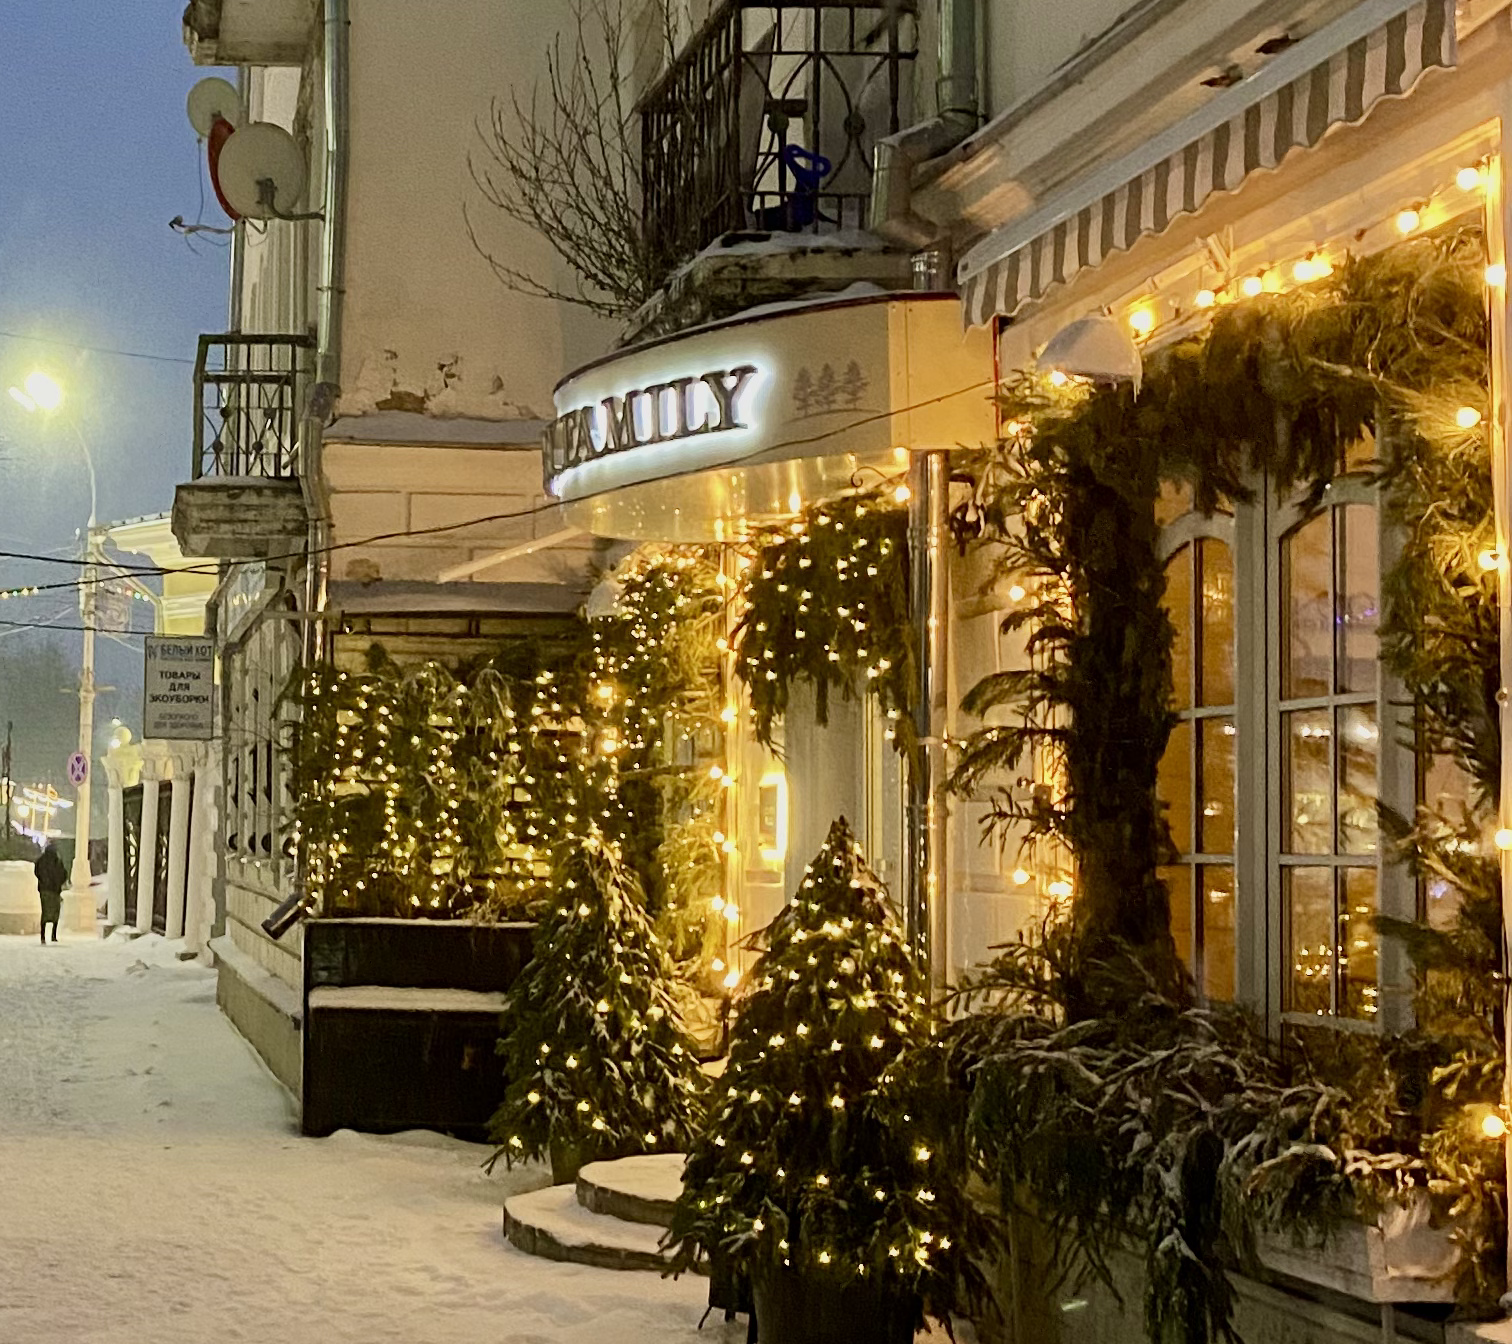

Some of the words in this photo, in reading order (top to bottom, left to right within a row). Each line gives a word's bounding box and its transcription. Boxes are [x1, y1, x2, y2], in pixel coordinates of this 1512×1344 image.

[559, 364, 758, 472] FAMILY
[159, 670, 201, 680] ТОВАРЫ
[168, 683, 190, 692] ДЛЯ
